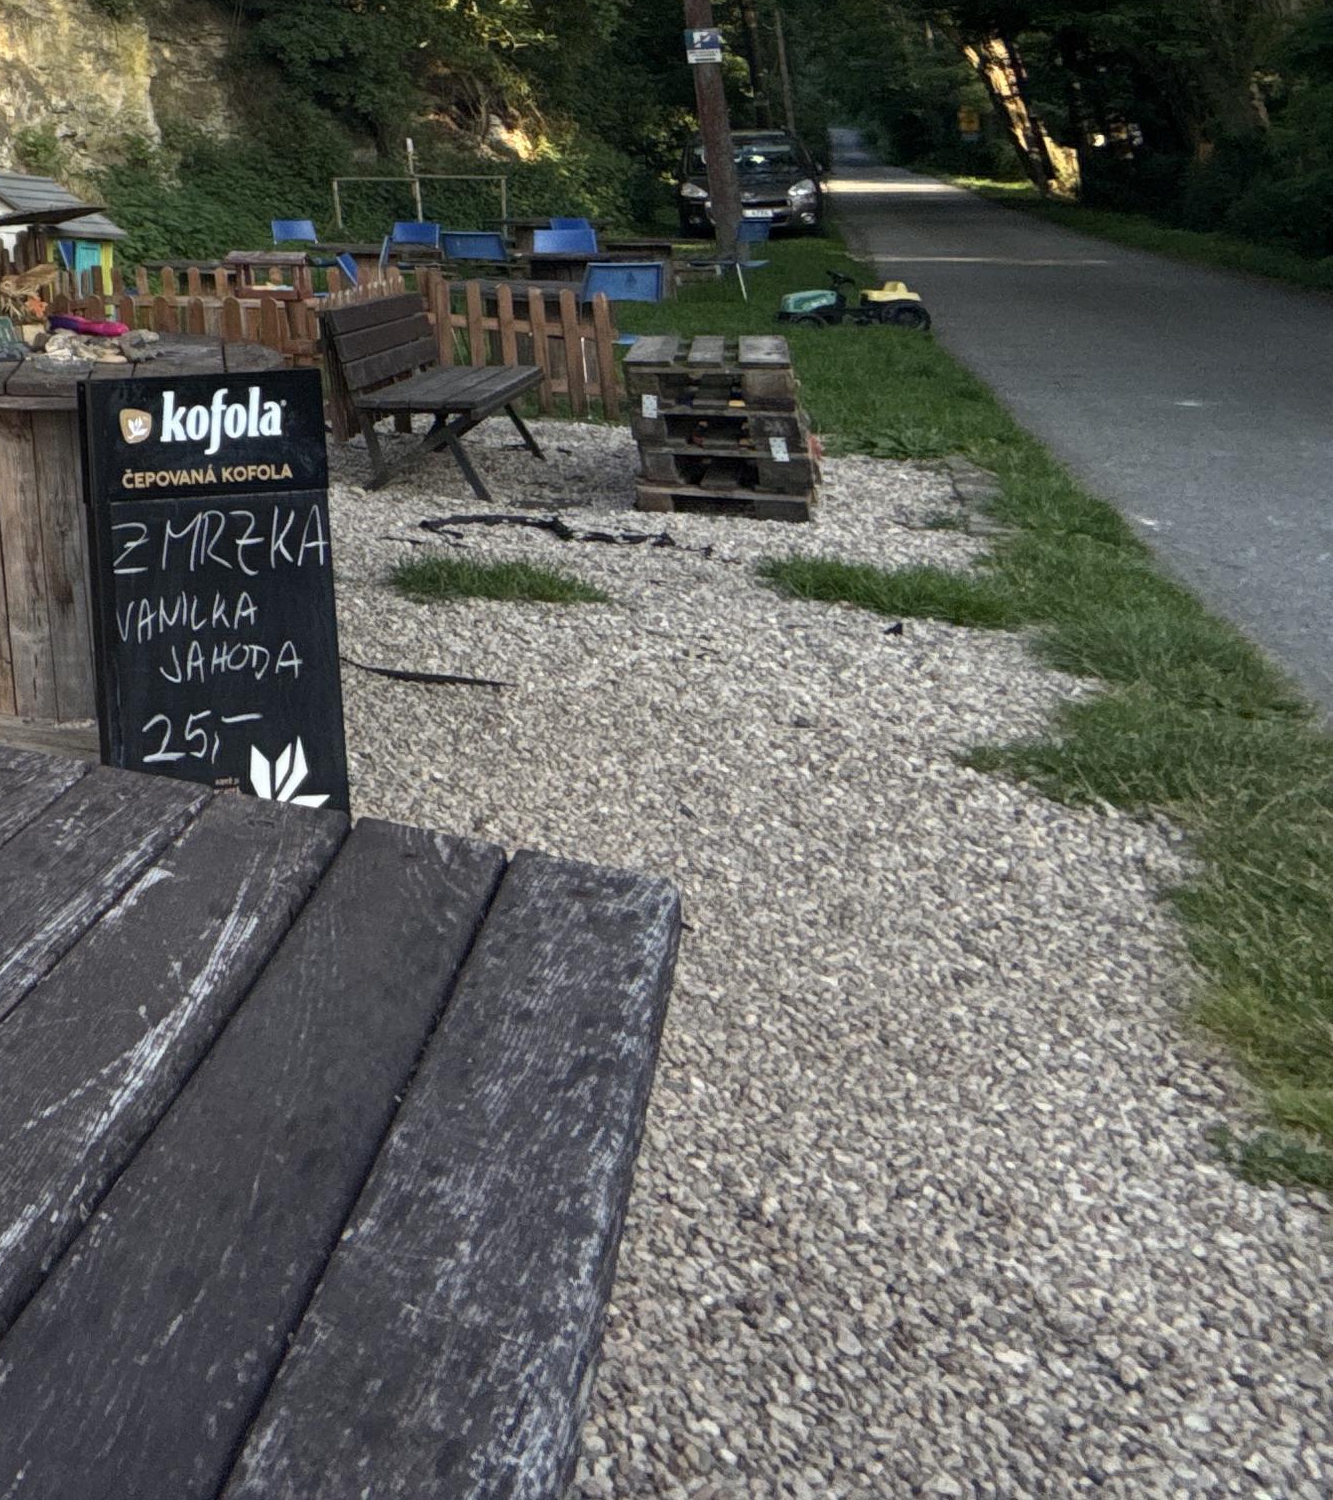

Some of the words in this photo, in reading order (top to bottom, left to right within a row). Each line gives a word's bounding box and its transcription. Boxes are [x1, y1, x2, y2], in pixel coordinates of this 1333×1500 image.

[159, 386, 283, 455] kofola
[122, 463, 217, 490] ČEPOVANÁ
[221, 462, 293, 484] KOFOLA
[112, 504, 329, 576] ZMRZKA
[116, 590, 257, 645] VANILKA
[159, 640, 303, 684] JAHODA
[142, 710, 264, 764] 25,-
